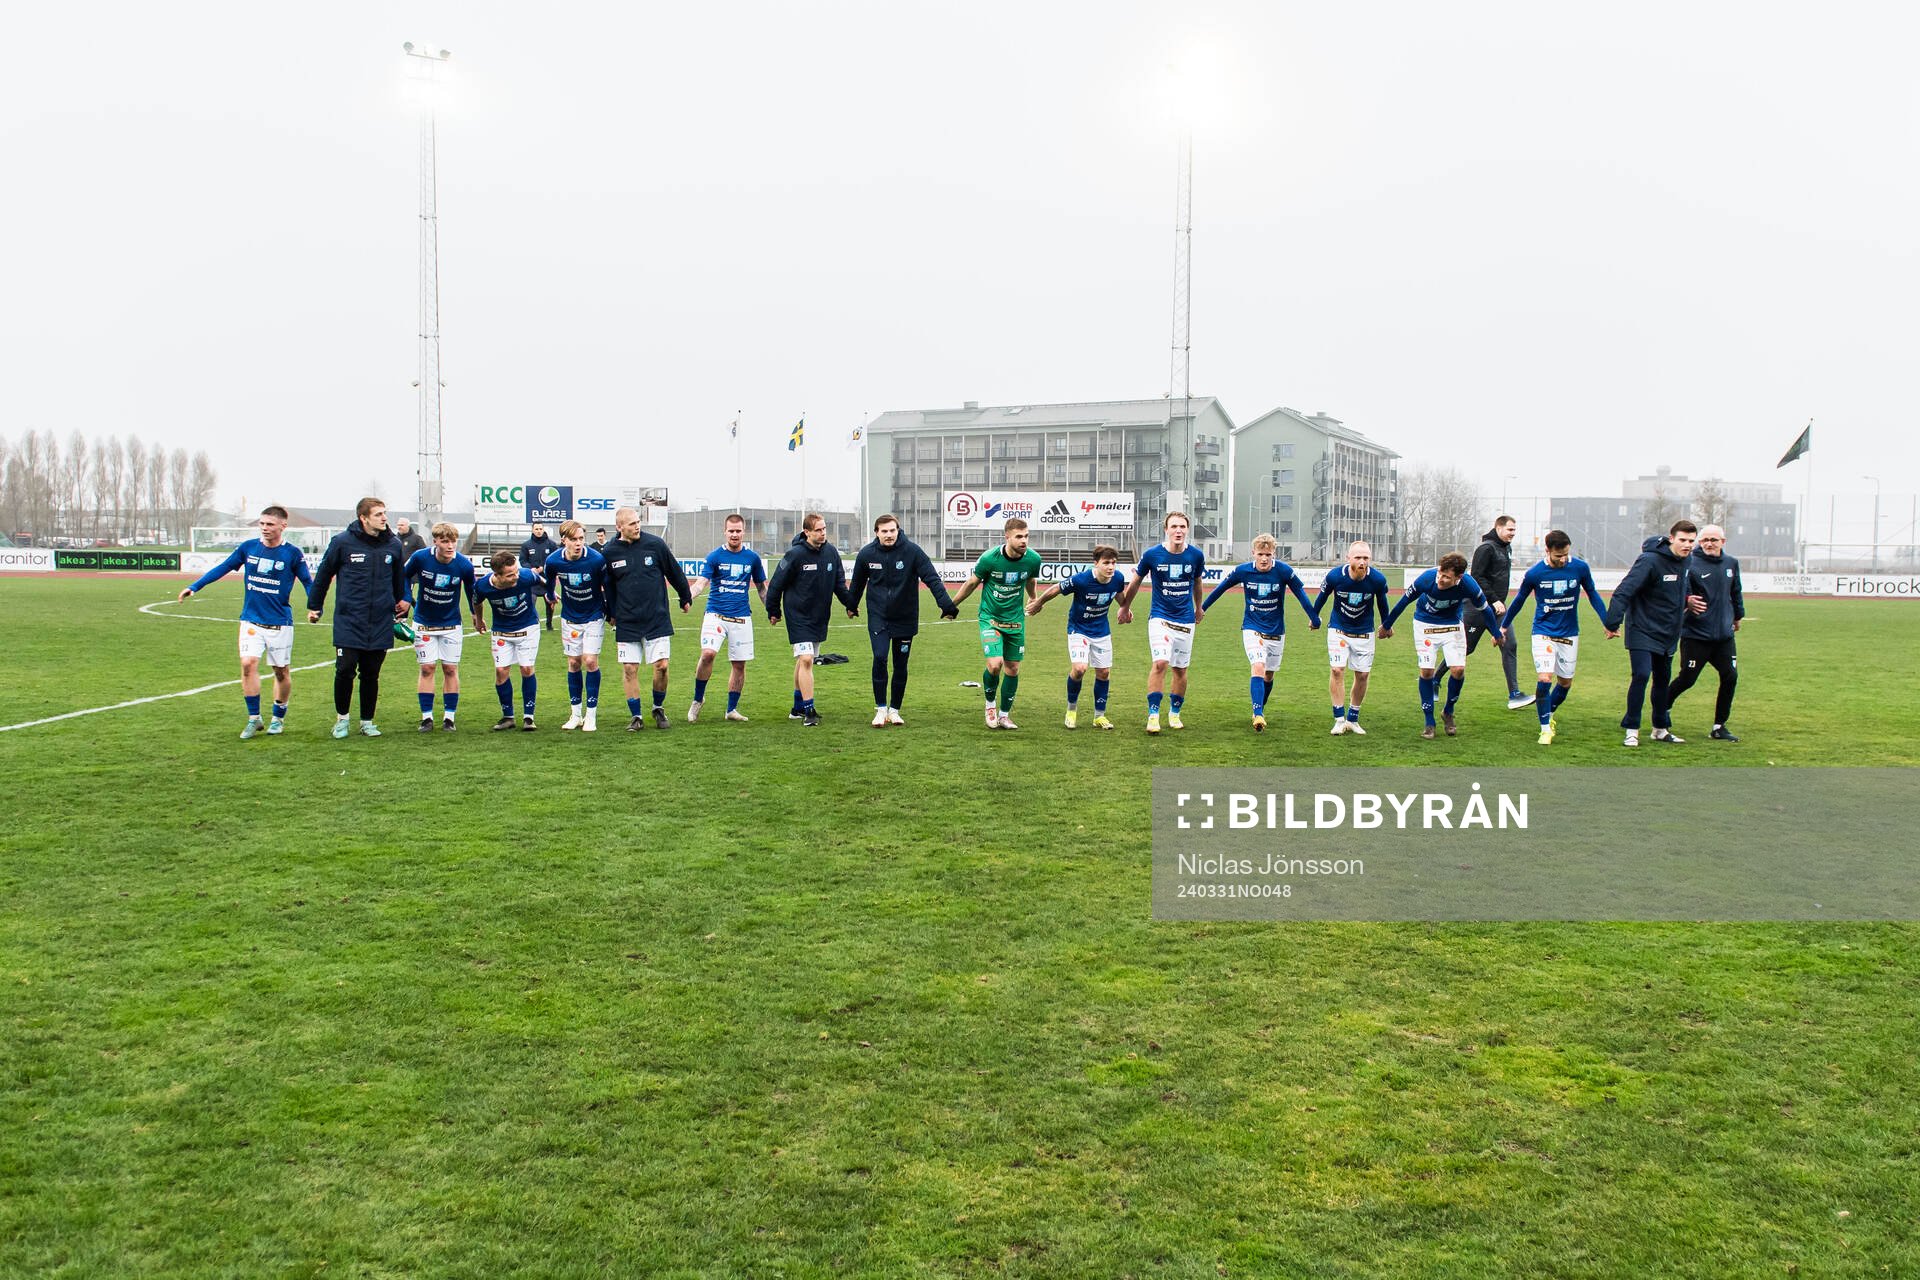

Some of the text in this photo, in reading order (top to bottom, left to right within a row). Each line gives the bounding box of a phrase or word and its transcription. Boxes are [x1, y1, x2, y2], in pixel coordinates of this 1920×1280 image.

[481, 486, 523, 504] RCC
[577, 498, 616, 510] SSE
[1003, 502, 1033, 511] INTER
[1002, 510, 1031, 519] SPORT
[1040, 513, 1076, 524] adidas
[0, 552, 48, 566] ranitor
[60, 555, 86, 565] akea
[103, 556, 127, 566] akea
[143, 557, 167, 566] akea
